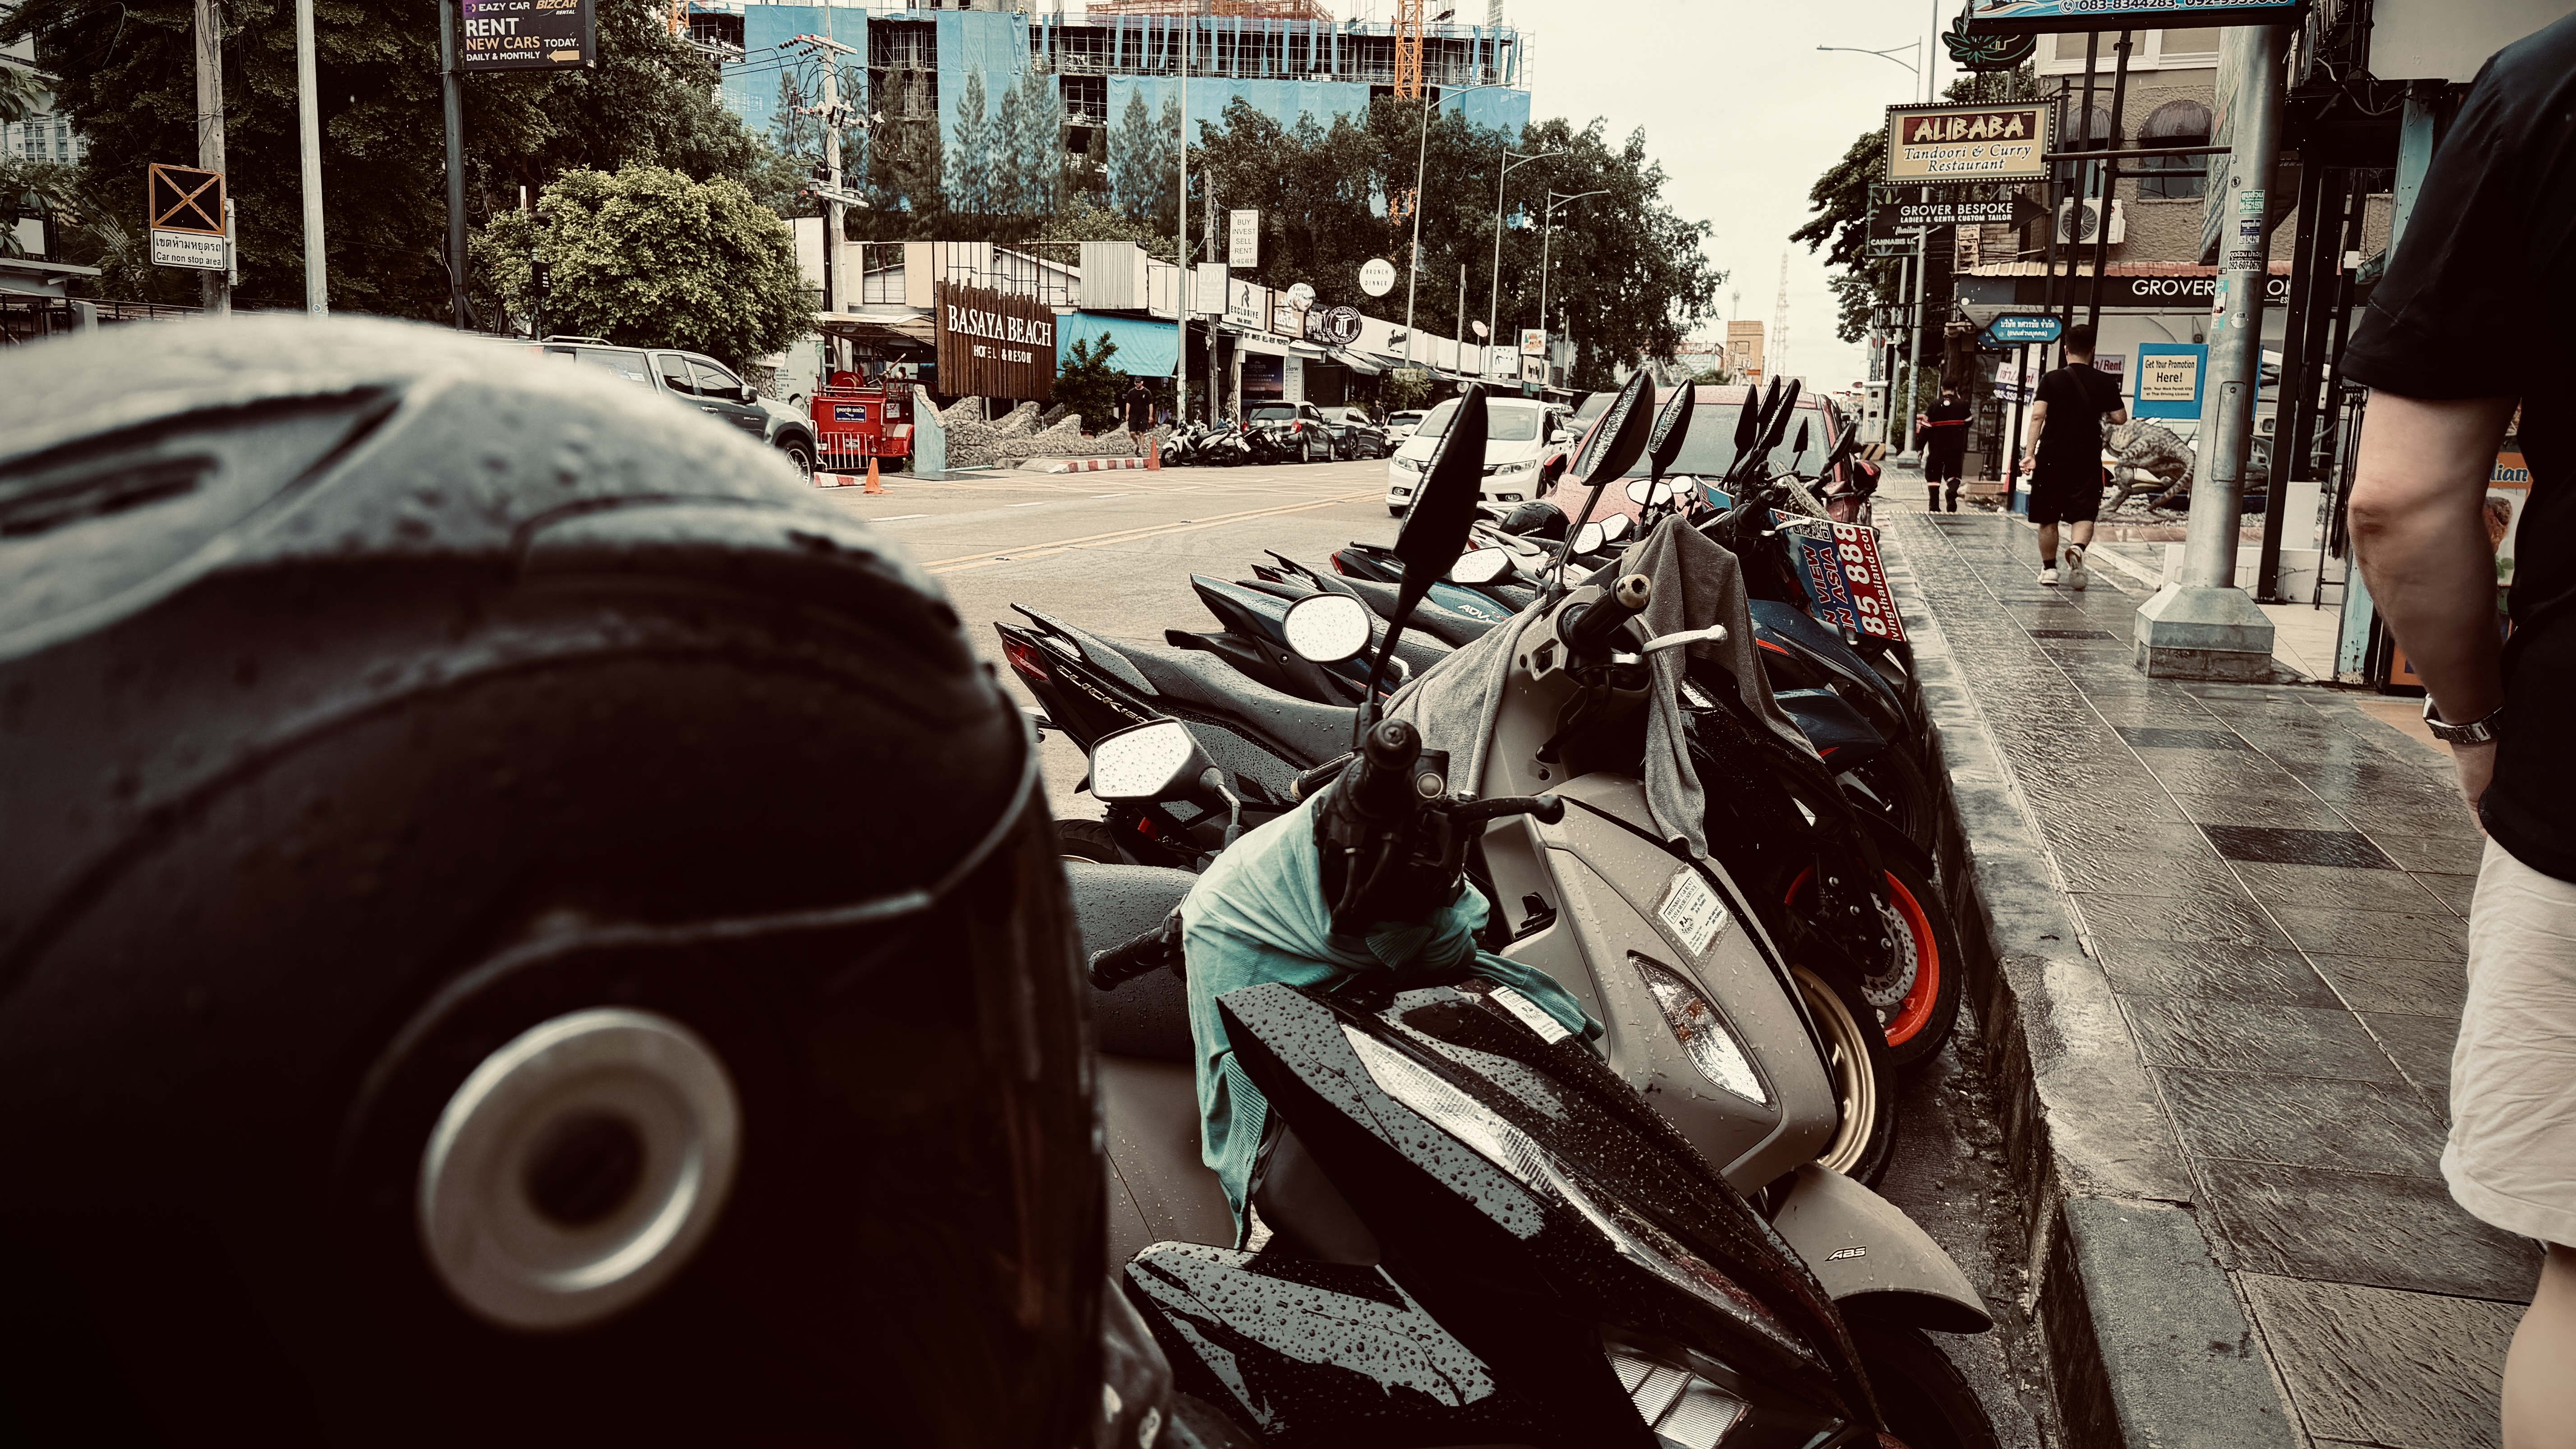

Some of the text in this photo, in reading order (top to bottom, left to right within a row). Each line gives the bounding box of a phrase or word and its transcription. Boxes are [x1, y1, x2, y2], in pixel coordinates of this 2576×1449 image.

[479, 1, 530, 11] EAZY CAR
[536, 0, 577, 9] BIZCAR
[466, 18, 519, 37] RENT
[466, 36, 579, 51] NEW CARS TODAY.
[466, 51, 540, 61] DAILY & MONTHLY
[1913, 114, 2024, 142] ALIBABA
[1904, 144, 2031, 160] Tandoori & Curry
[1927, 158, 2005, 172] Restaurant
[1900, 203, 2013, 216] GROVER BESPOKE
[156, 236, 221, 254] เขตห้ามหยุดรถ
[156, 252, 169, 261] Car
[188, 256, 203, 265] stop
[2132, 280, 2215, 295] GROVER
[1231, 305, 1259, 319] EXCLUSIVE
[948, 304, 1052, 346] BASAYA BEACH
[974, 345, 997, 359] HOTEL
[2145, 359, 2194, 368] Get Your Promotion
[2157, 372, 2182, 382] Here!
[1802, 544, 1831, 603] VIEW
[1820, 547, 1848, 604] ASIA
[1458, 605, 1490, 619] ADV
[1829, 1248, 1865, 1260] ABS
